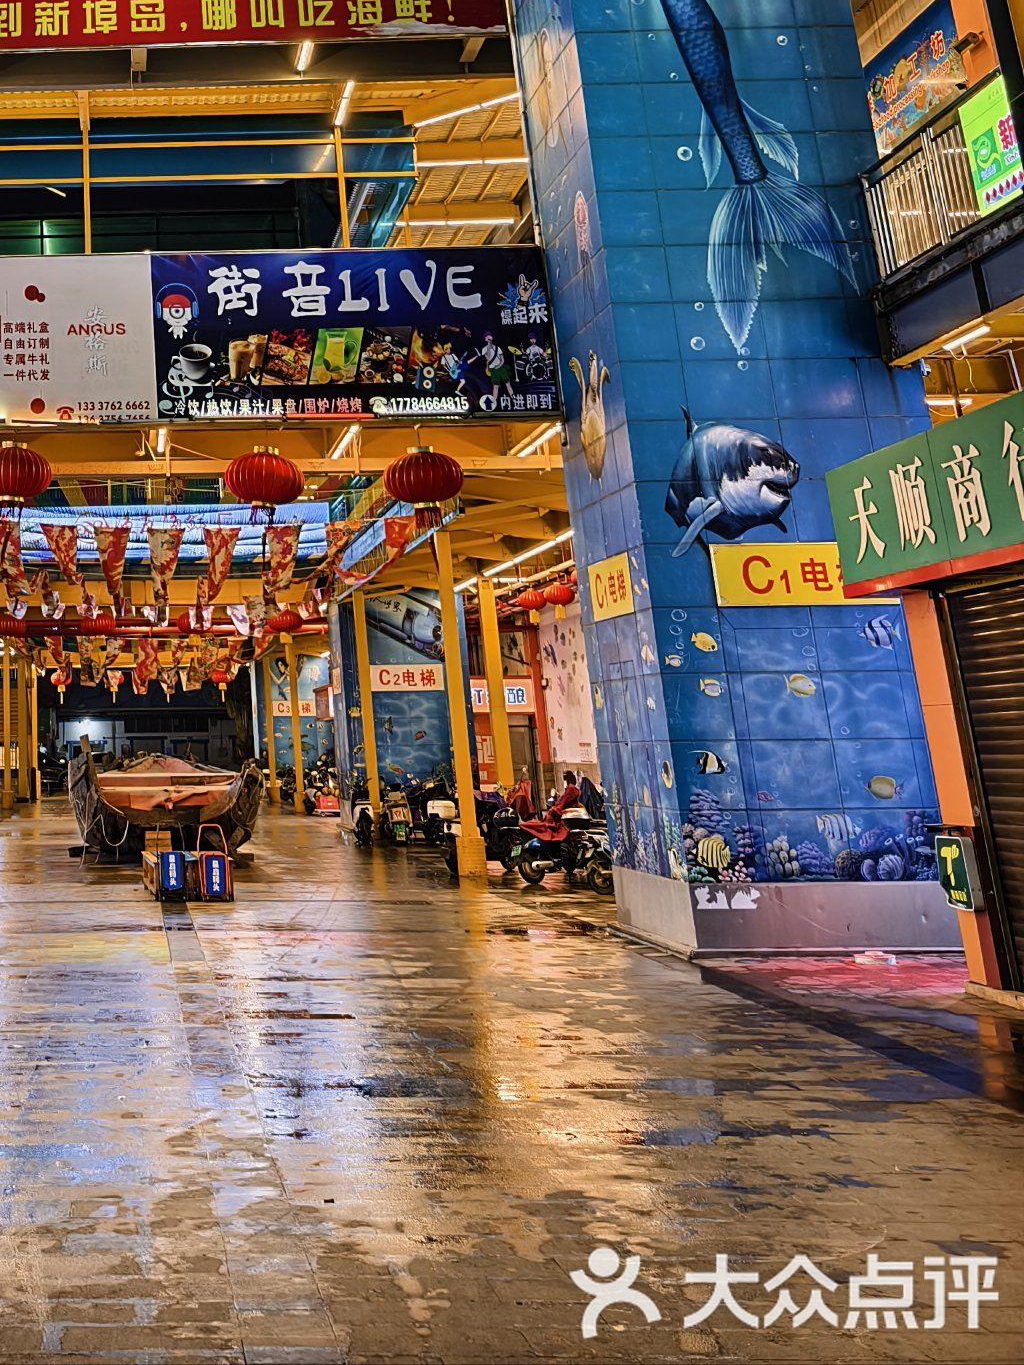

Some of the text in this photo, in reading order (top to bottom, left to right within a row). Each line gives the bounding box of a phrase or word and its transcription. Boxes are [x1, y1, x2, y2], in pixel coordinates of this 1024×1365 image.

[3, 321, 50, 334] 高端礼盒
[67, 323, 126, 336] ANGUS
[3, 337, 50, 351] 自由订制
[84, 305, 109, 377] 安格斯
[3, 353, 50, 366] 专属牛礼
[3, 369, 50, 382] 一件代发
[77, 400, 151, 411] 133 3762 6662
[390, 396, 470, 413] 17784664815
[500, 393, 553, 411] 内进即到
[742, 555, 844, 595] C1电
[594, 569, 627, 610] C1电梯
[379, 668, 436, 687] C2电梯
[277, 701, 312, 715] C3梯
